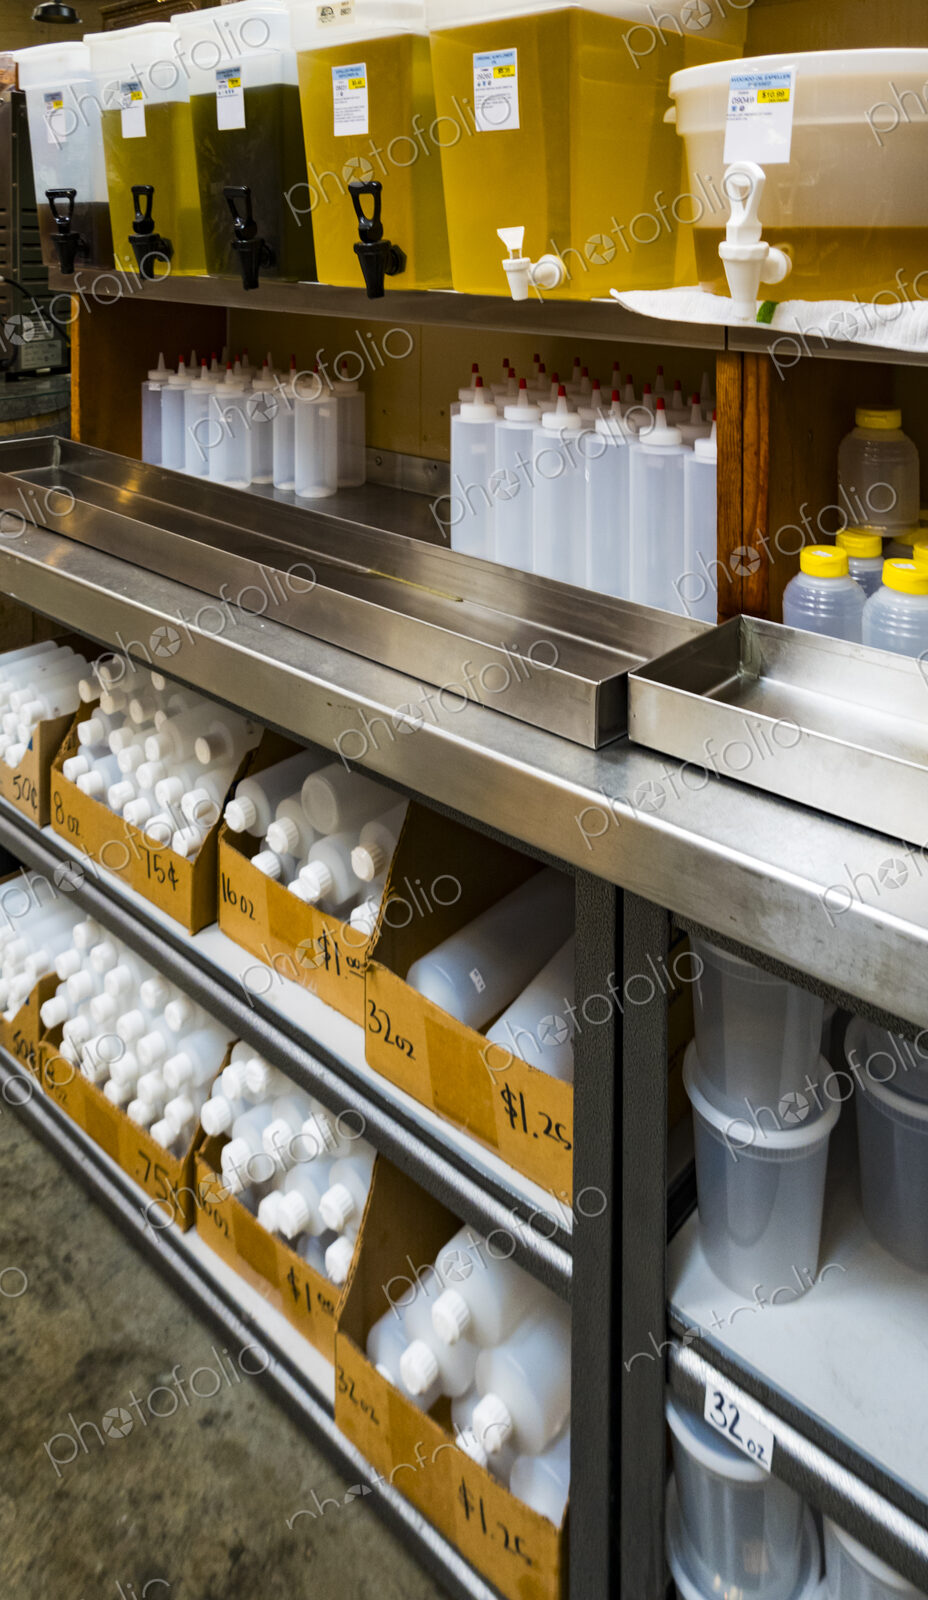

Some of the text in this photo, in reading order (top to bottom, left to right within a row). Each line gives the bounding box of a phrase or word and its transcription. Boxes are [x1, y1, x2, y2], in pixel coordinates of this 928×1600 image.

[54, 791, 65, 824] 8
[222, 872, 237, 905] 16
[500, 1082, 572, 1150] $1.25
[710, 1390, 743, 1444] 32
